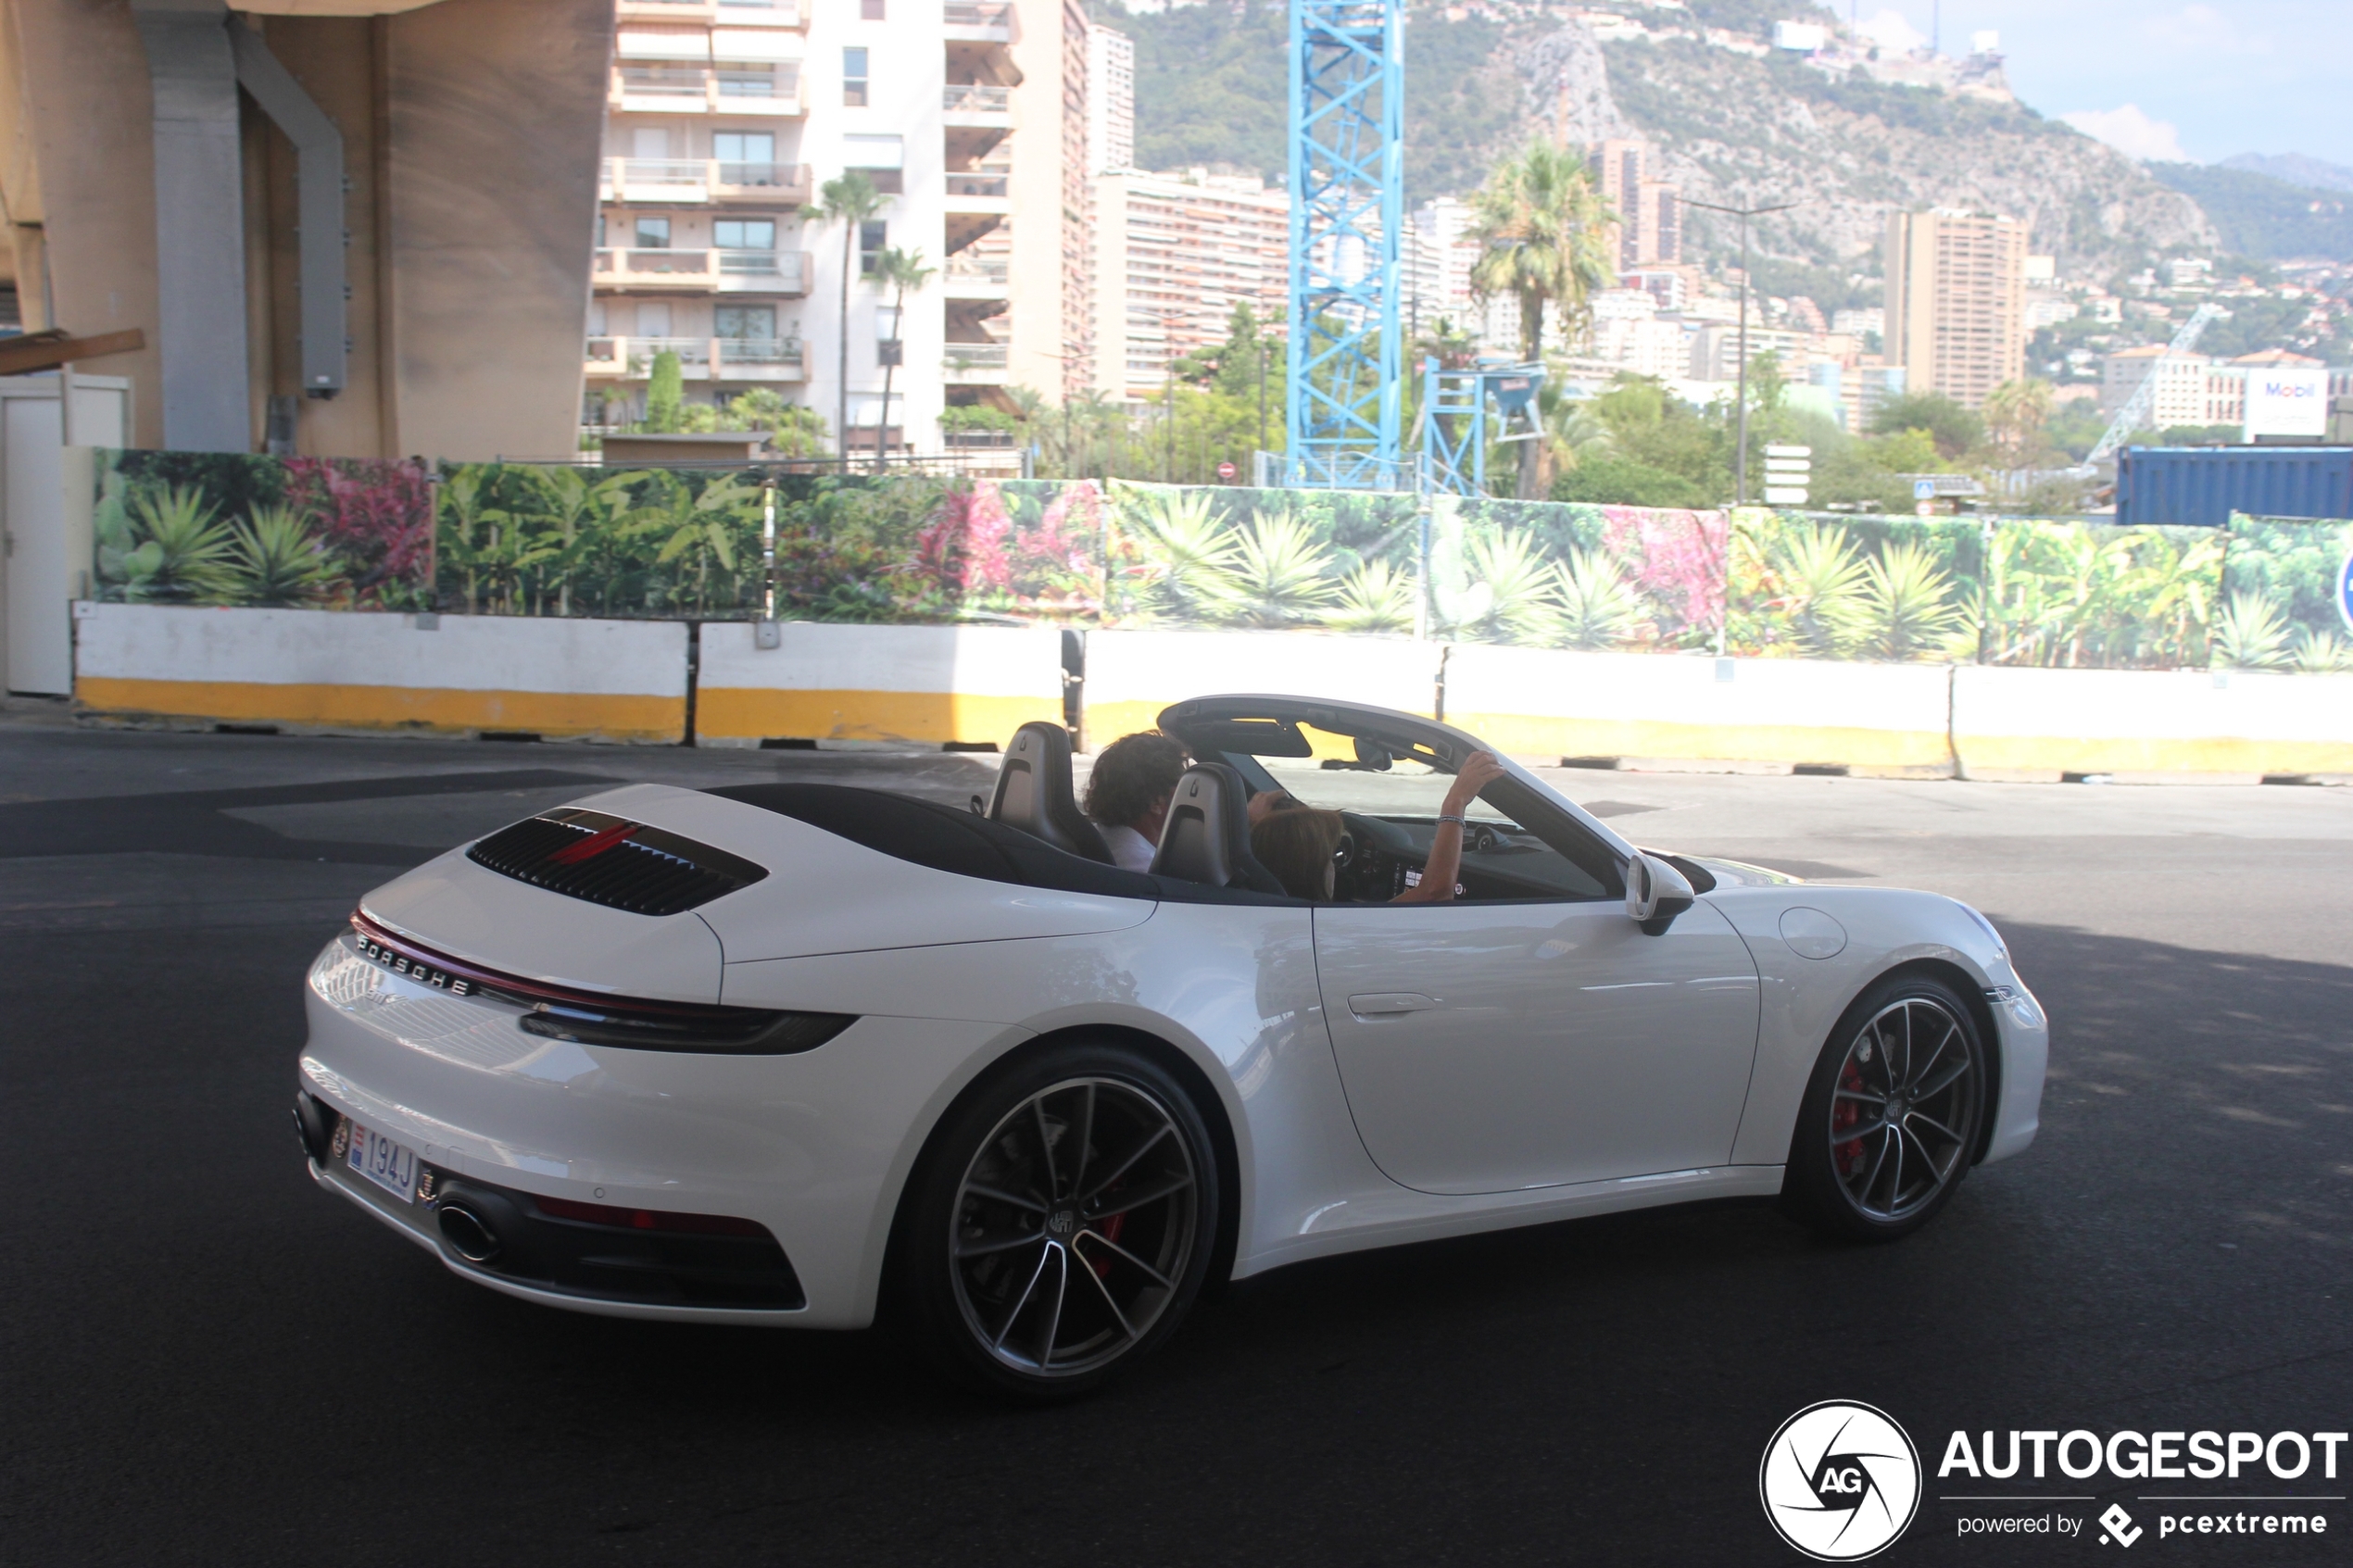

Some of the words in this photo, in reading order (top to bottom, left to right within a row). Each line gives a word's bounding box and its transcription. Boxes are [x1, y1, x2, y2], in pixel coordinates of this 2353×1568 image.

[2266, 382, 2315, 398] Mobil
[356, 936, 470, 997] PORSCHE
[368, 1131, 413, 1188] 194J
